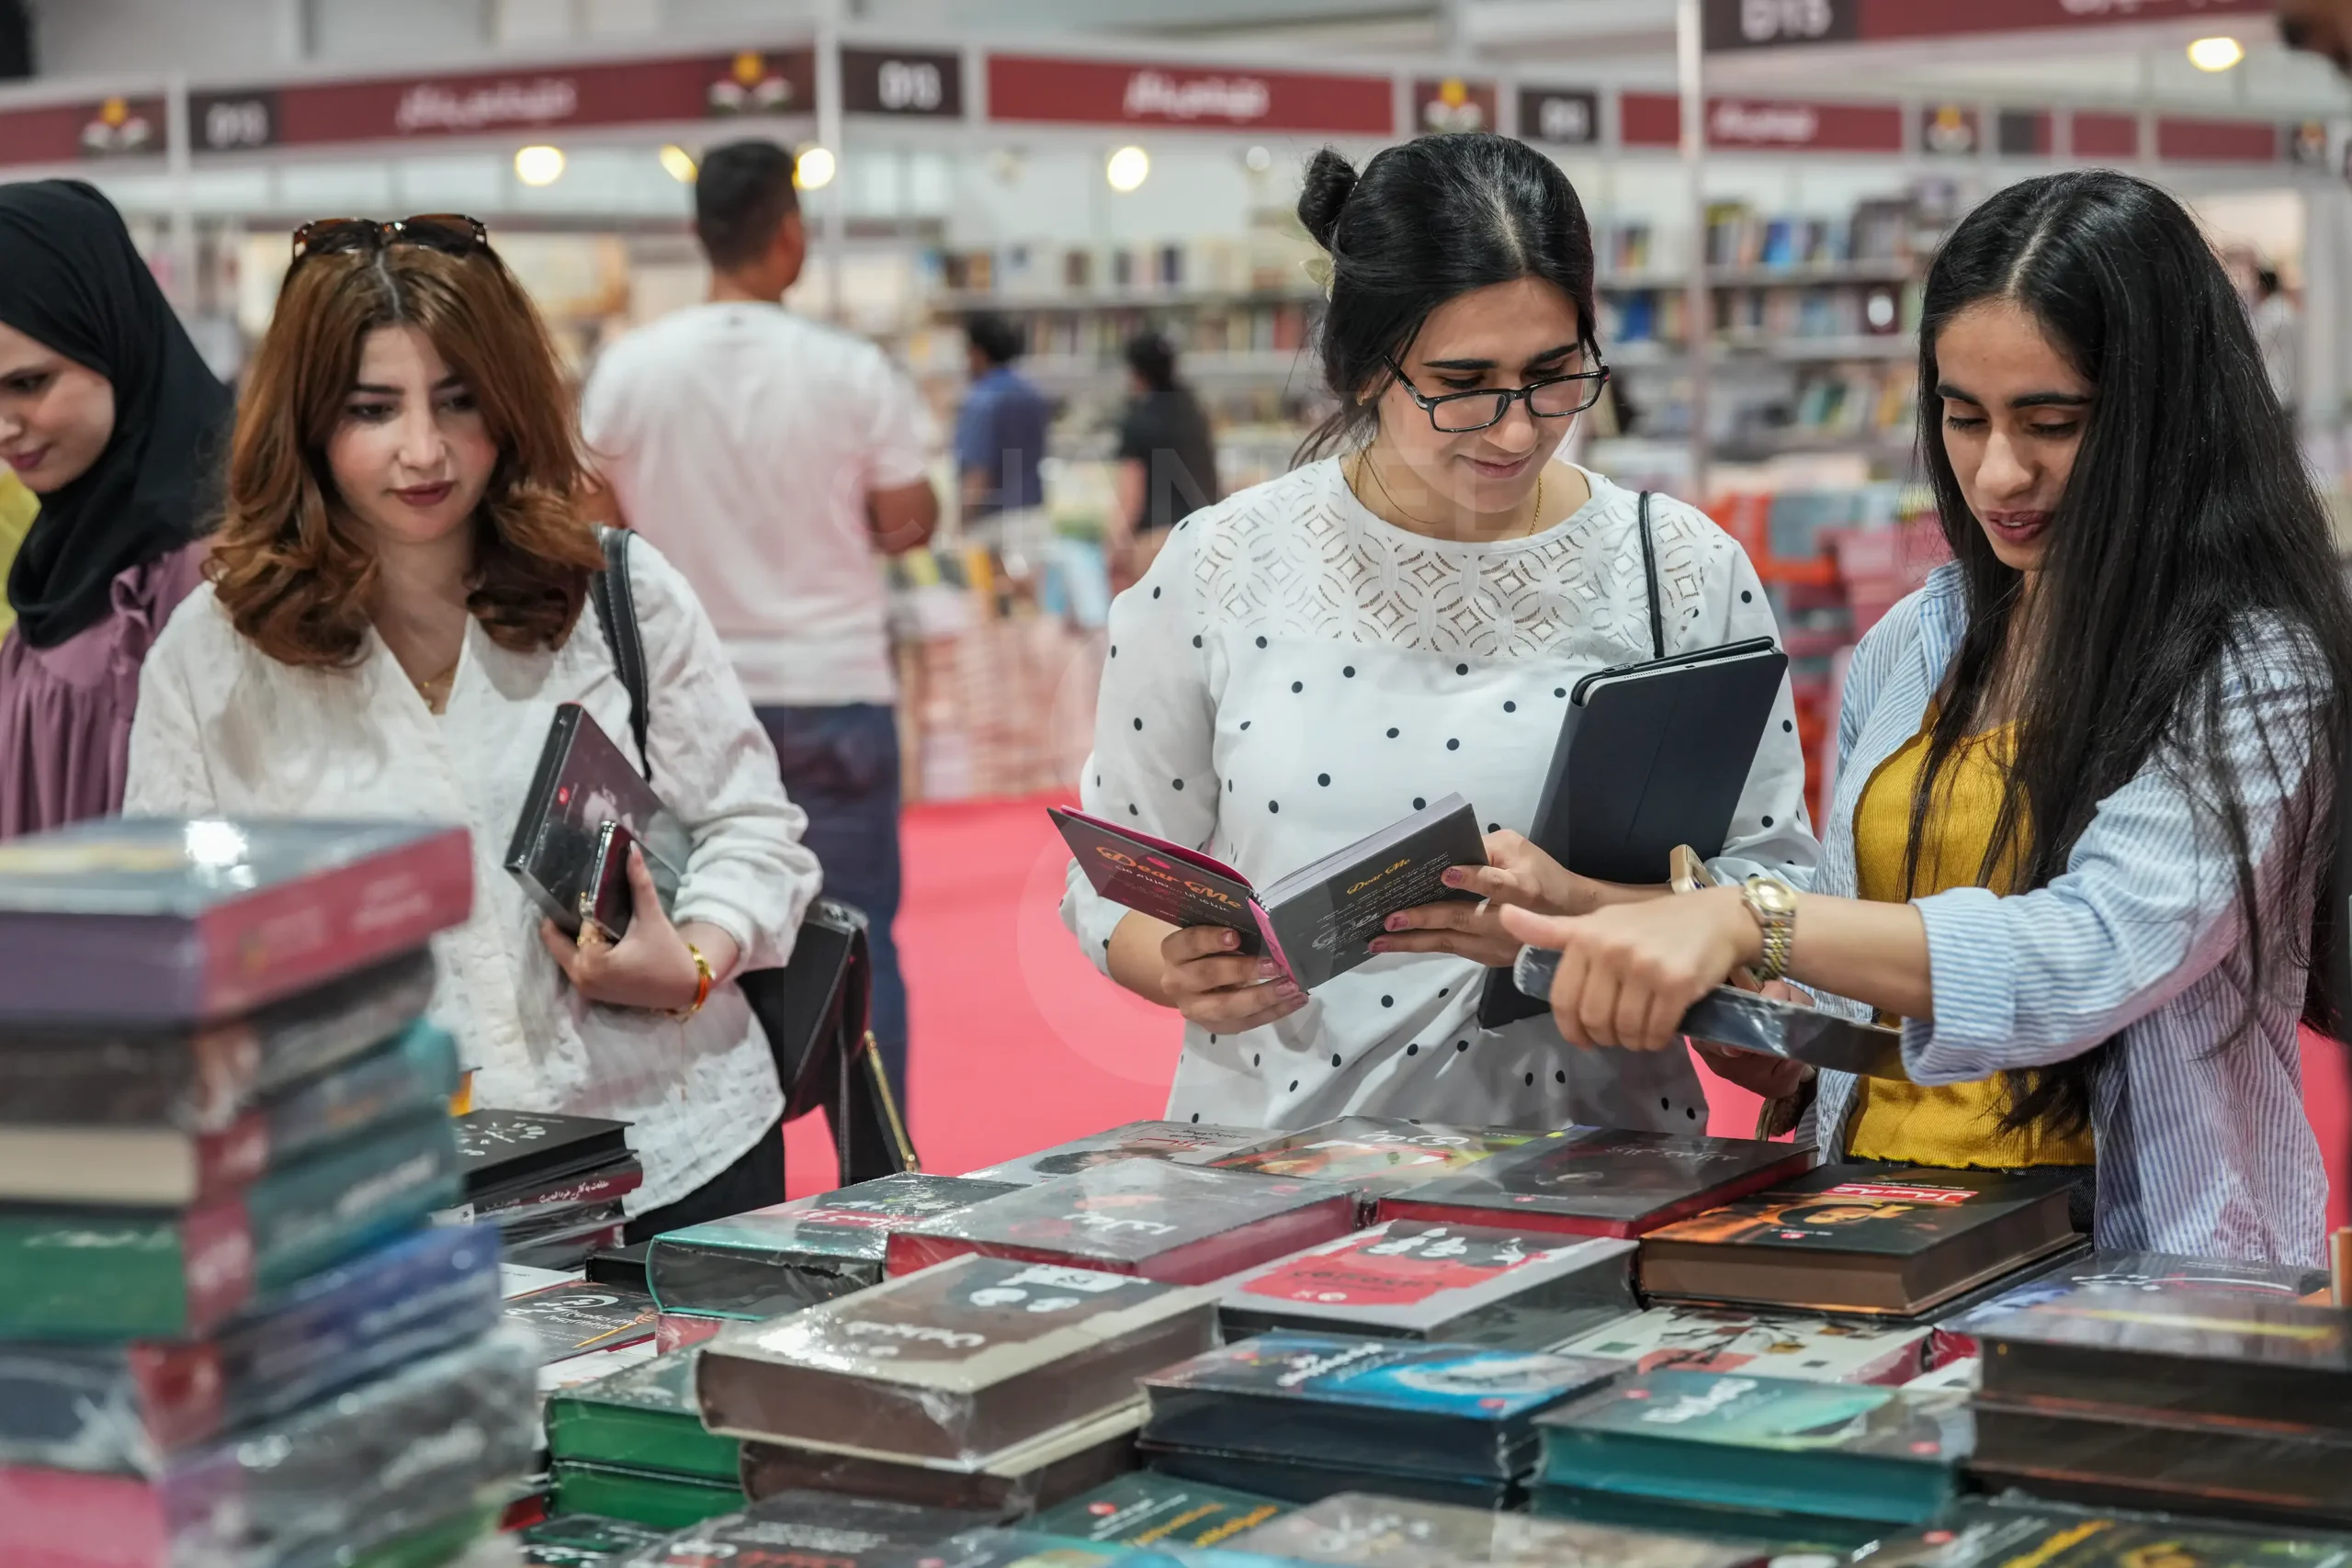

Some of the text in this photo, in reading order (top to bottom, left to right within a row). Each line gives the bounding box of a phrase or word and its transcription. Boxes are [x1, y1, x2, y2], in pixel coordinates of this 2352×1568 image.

[1095, 846, 1182, 884] Dear
[1183, 880, 1244, 909] Me
[1346, 857, 1411, 896] Dear Me
